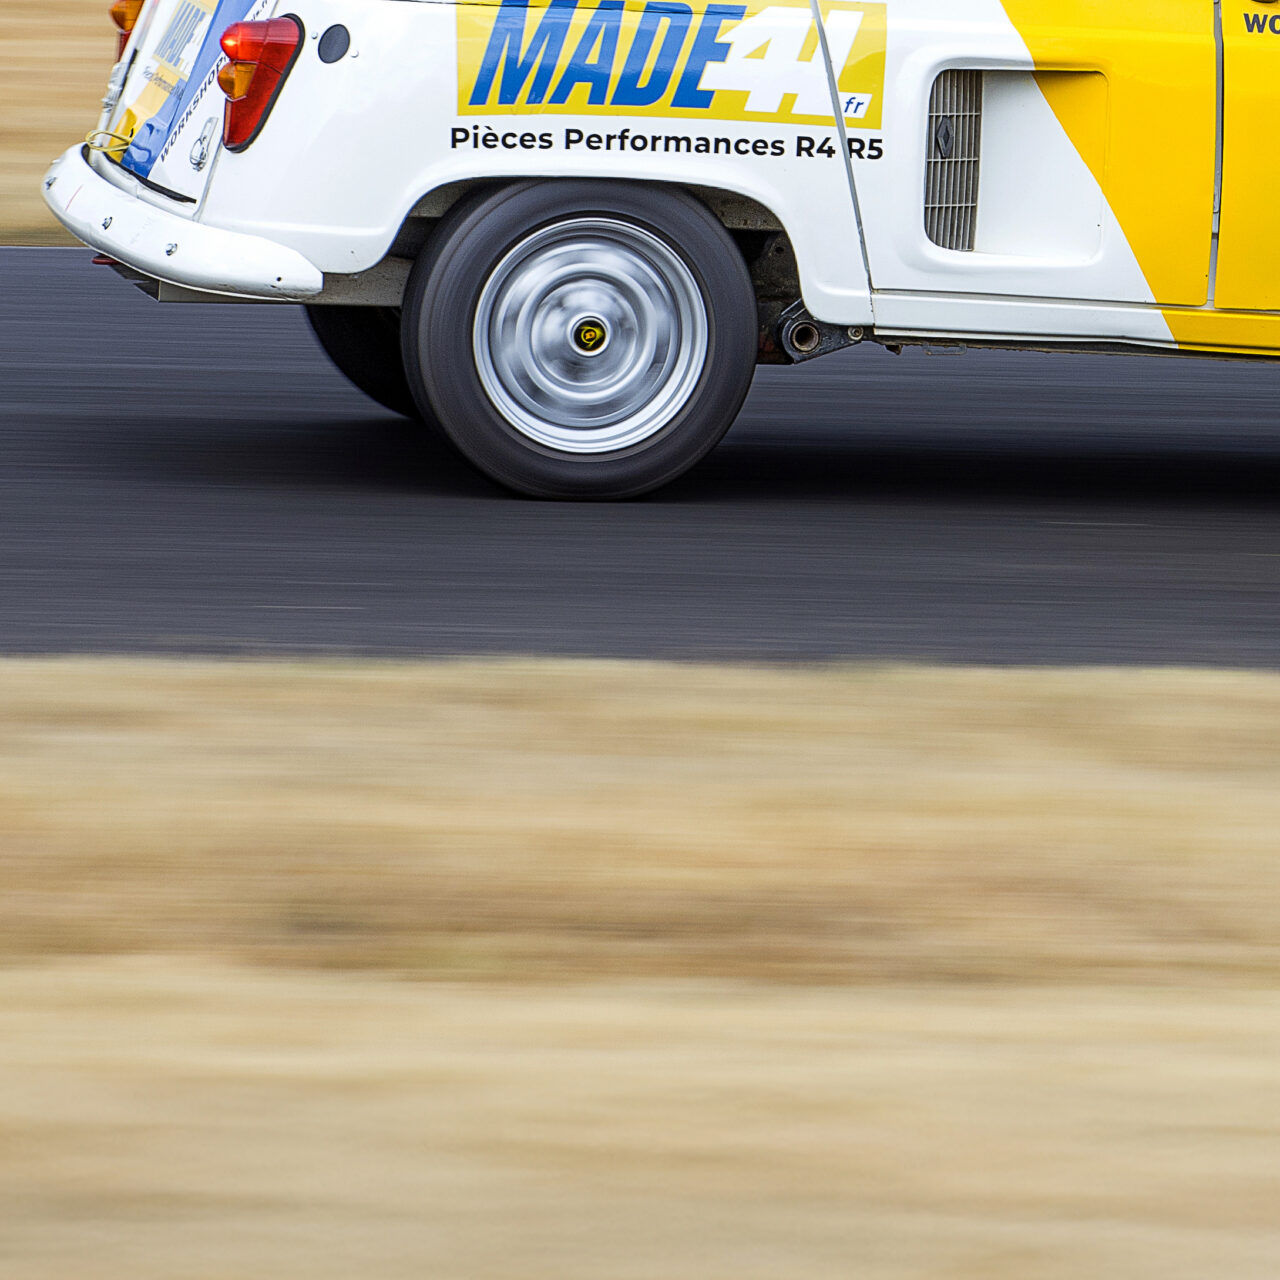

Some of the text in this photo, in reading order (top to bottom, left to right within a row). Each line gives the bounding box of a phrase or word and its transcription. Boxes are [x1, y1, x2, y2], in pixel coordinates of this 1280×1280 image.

[160, 60, 225, 163] WORKSHOP
[450, 125, 884, 161] Pièces Performances R4 R5
